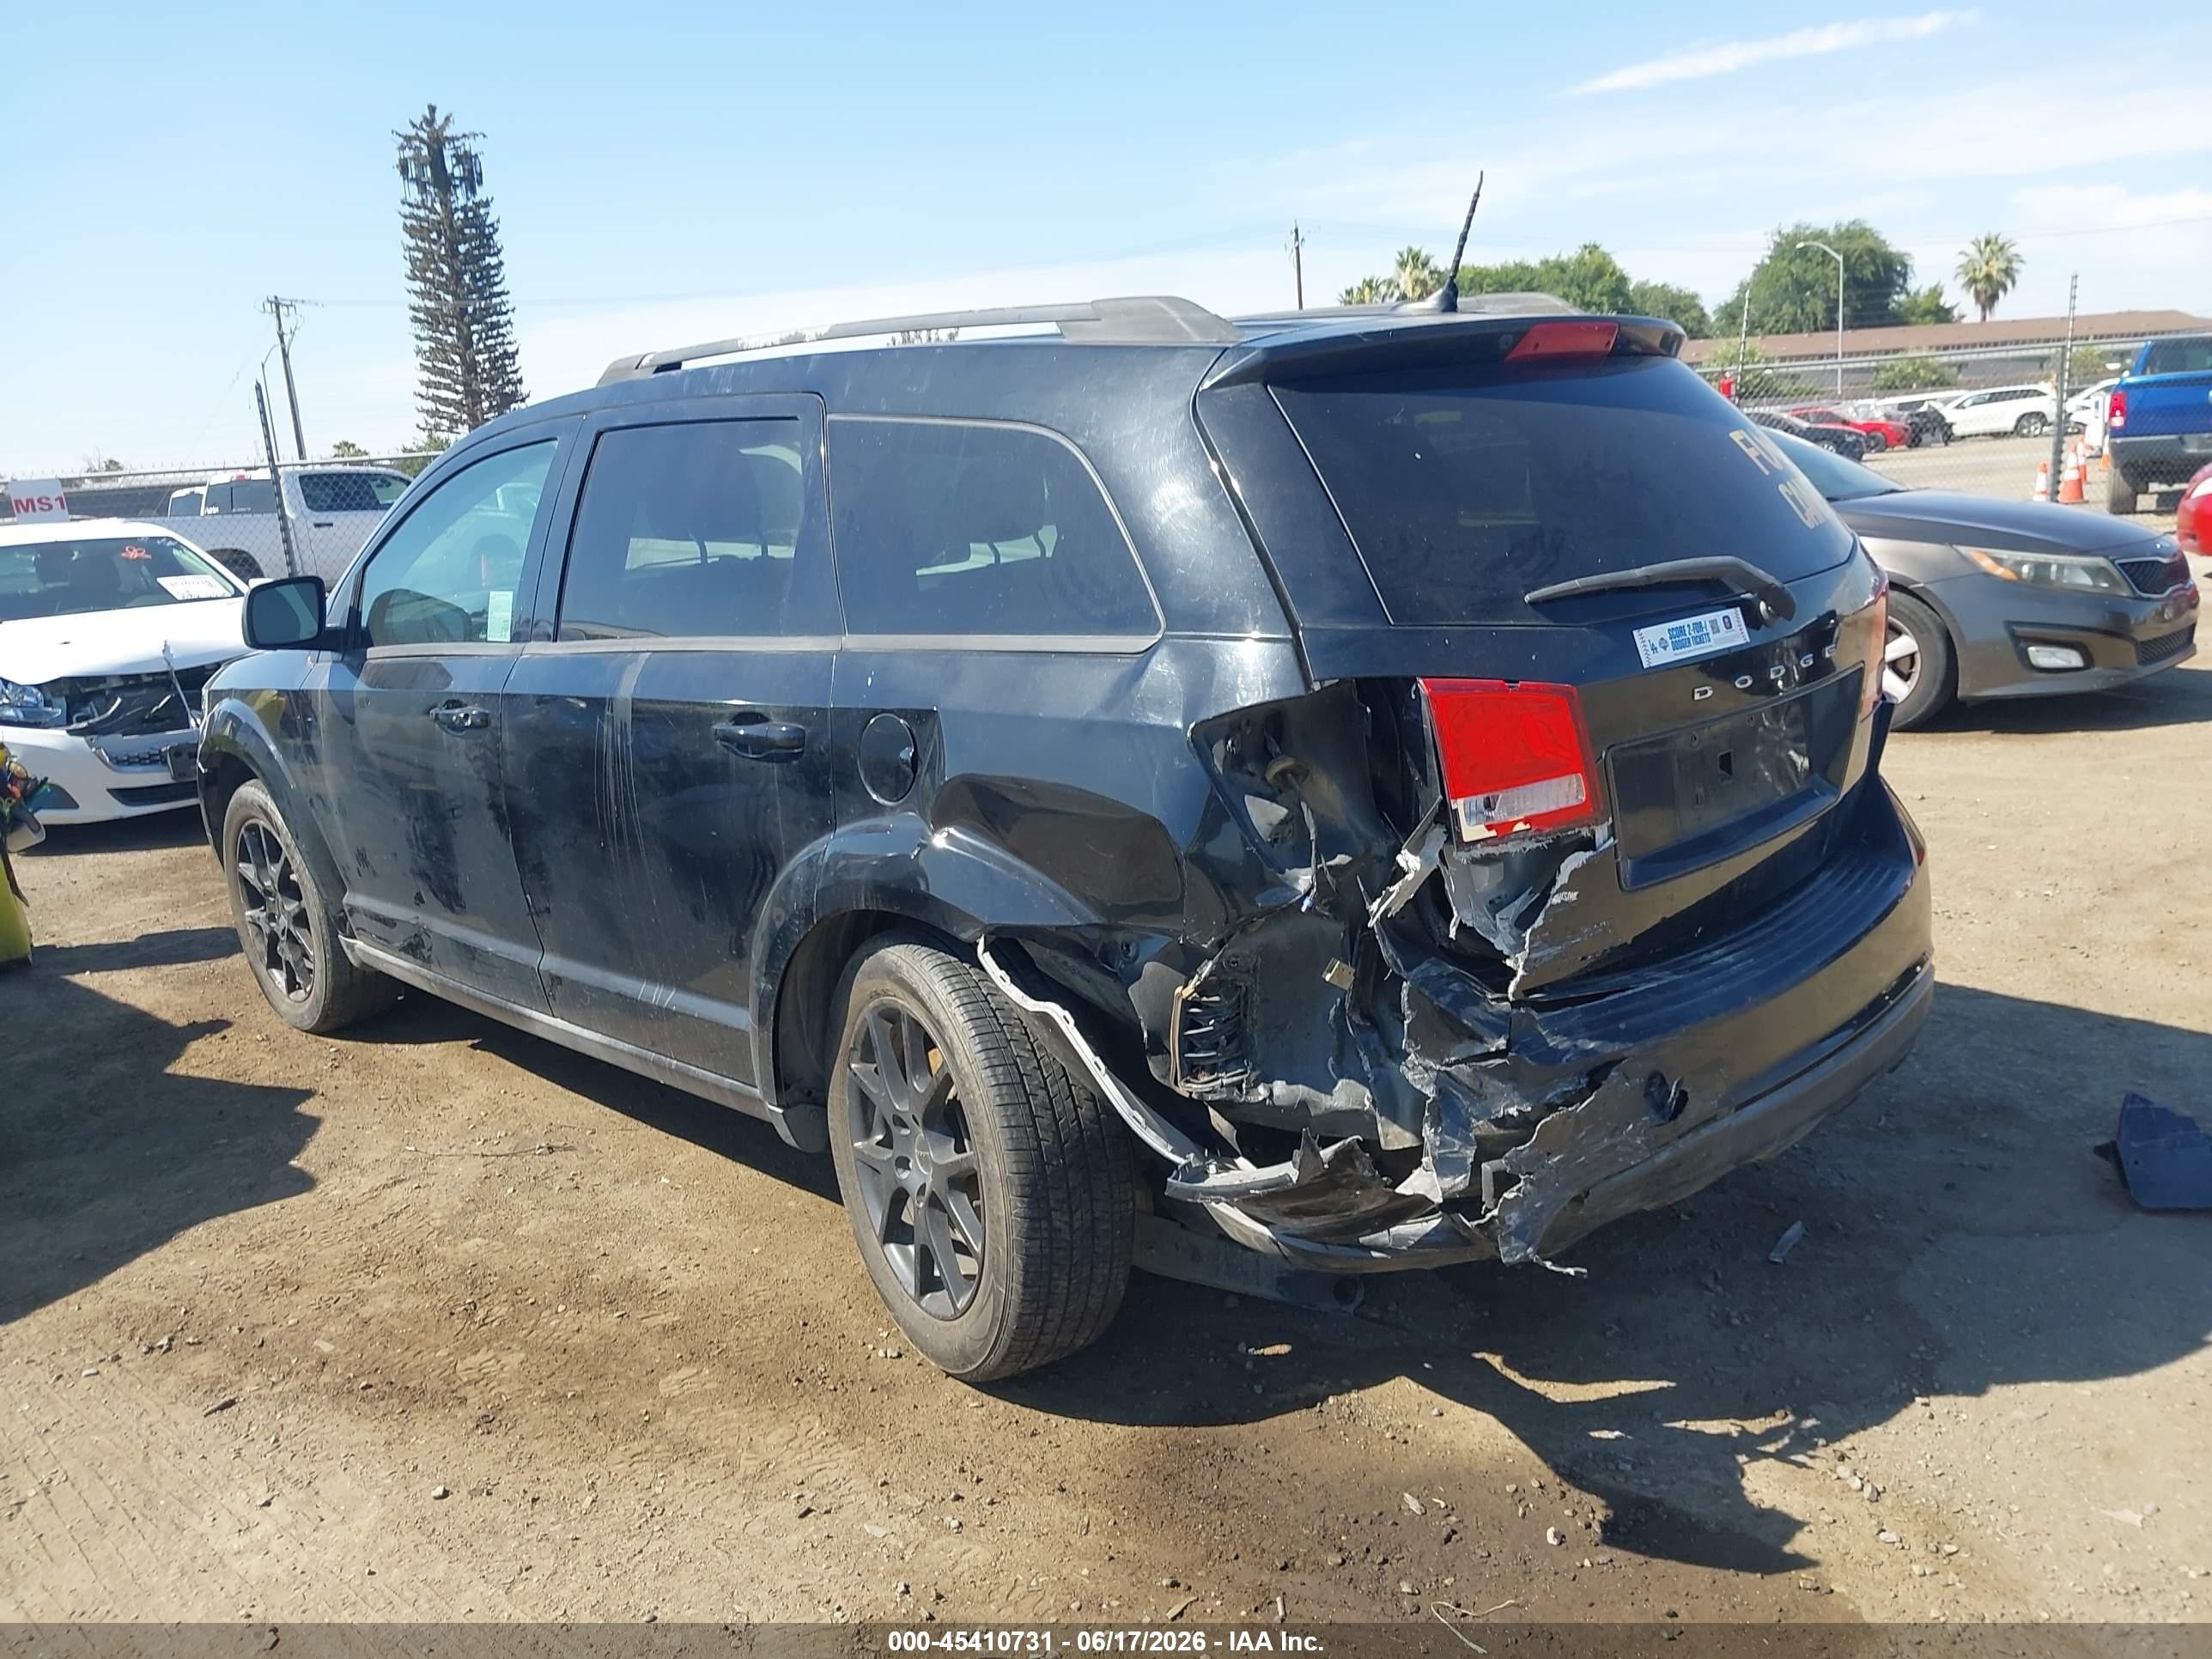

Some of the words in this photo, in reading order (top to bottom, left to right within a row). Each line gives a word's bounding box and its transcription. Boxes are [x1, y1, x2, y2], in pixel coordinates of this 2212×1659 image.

[13, 495, 65, 514] MS1
[1668, 624, 1686, 640] SCORE
[1671, 638, 1692, 652] DODGER
[1692, 632, 1711, 646] TICKETS
[1693, 645, 1837, 701] DODGE
